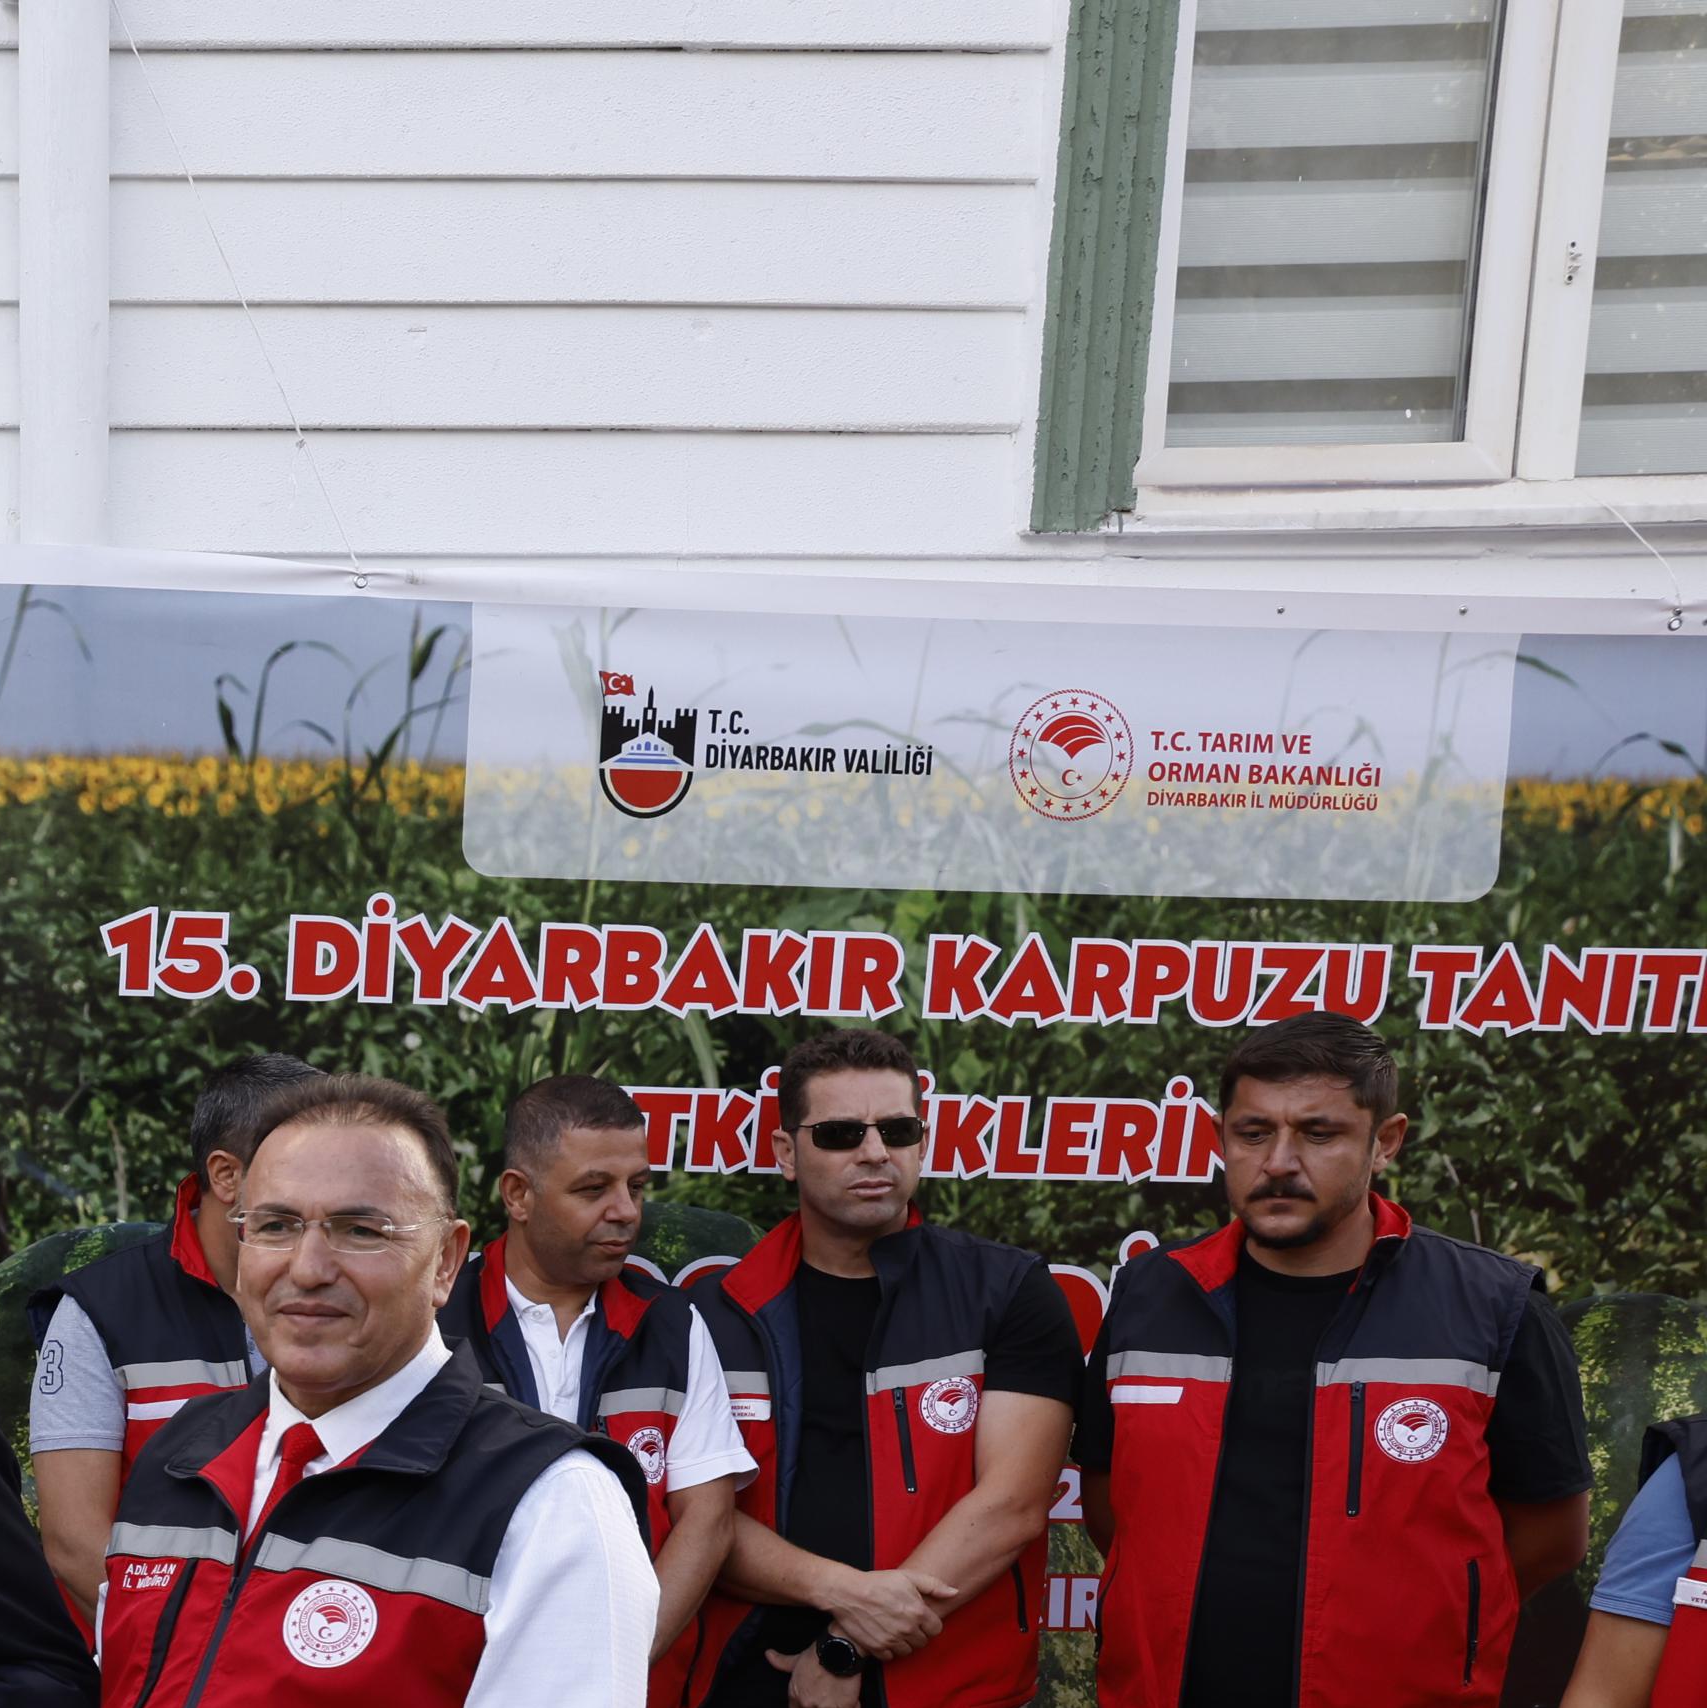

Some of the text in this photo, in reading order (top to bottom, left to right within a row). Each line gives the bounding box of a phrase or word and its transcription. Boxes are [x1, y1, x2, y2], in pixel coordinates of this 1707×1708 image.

[708, 709, 749, 735] T.C.
[1150, 730, 1312, 755] T.C. TARIM VE
[705, 738, 933, 776] DİYARBAKIR VALİLİĞİ
[1148, 762, 1381, 787] ORMAN BAKANLIĞI
[1146, 788, 1378, 811] DİYARBAKIR İL MÜDÜRLÜĞÜ
[100, 906, 260, 1001] 15.
[285, 892, 905, 1021] DİYARBAKIR
[922, 931, 1393, 1029] KARPUZU
[39, 1339, 64, 1395] 3
